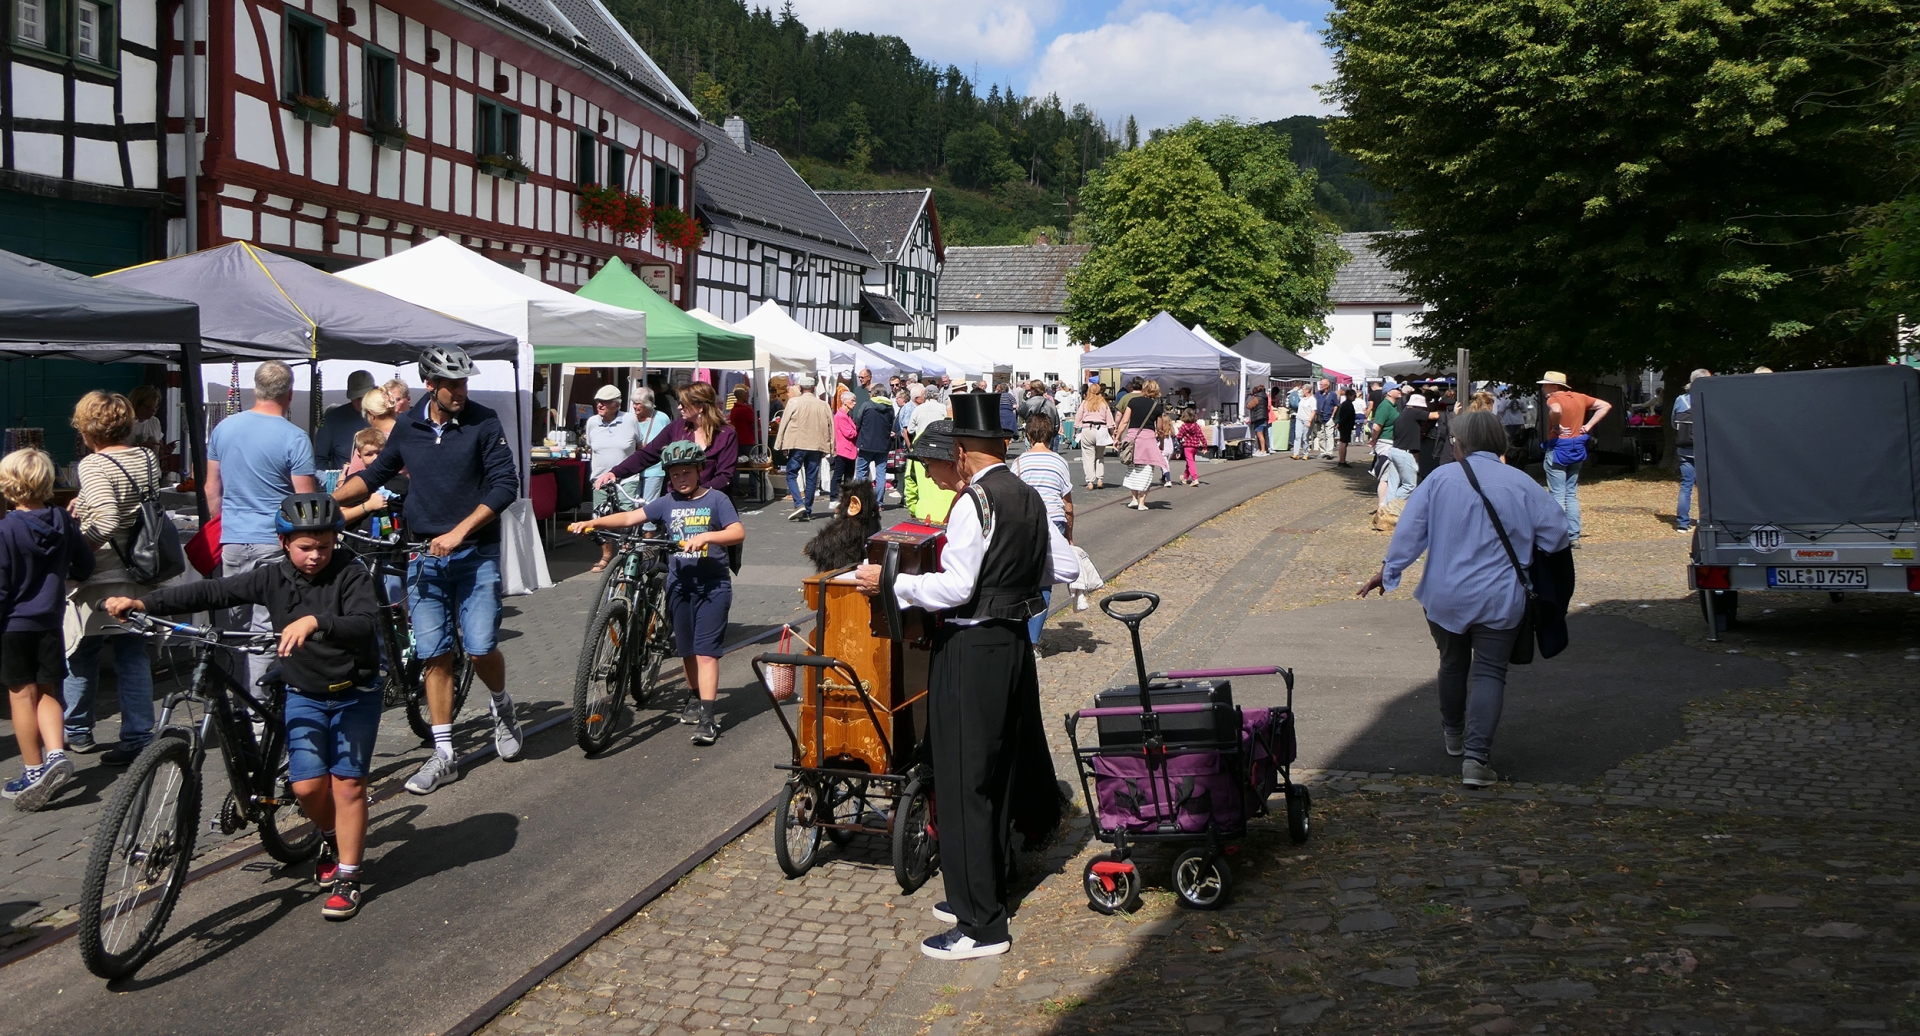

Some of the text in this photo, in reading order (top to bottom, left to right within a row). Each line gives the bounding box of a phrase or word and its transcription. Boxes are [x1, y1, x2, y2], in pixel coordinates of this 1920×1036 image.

[671, 508, 696, 517] BEACH
[685, 516, 711, 526] VACAY
[1754, 530, 1780, 548] 100
[1778, 570, 1805, 584] SLE
[1828, 570, 1865, 584] 7575
